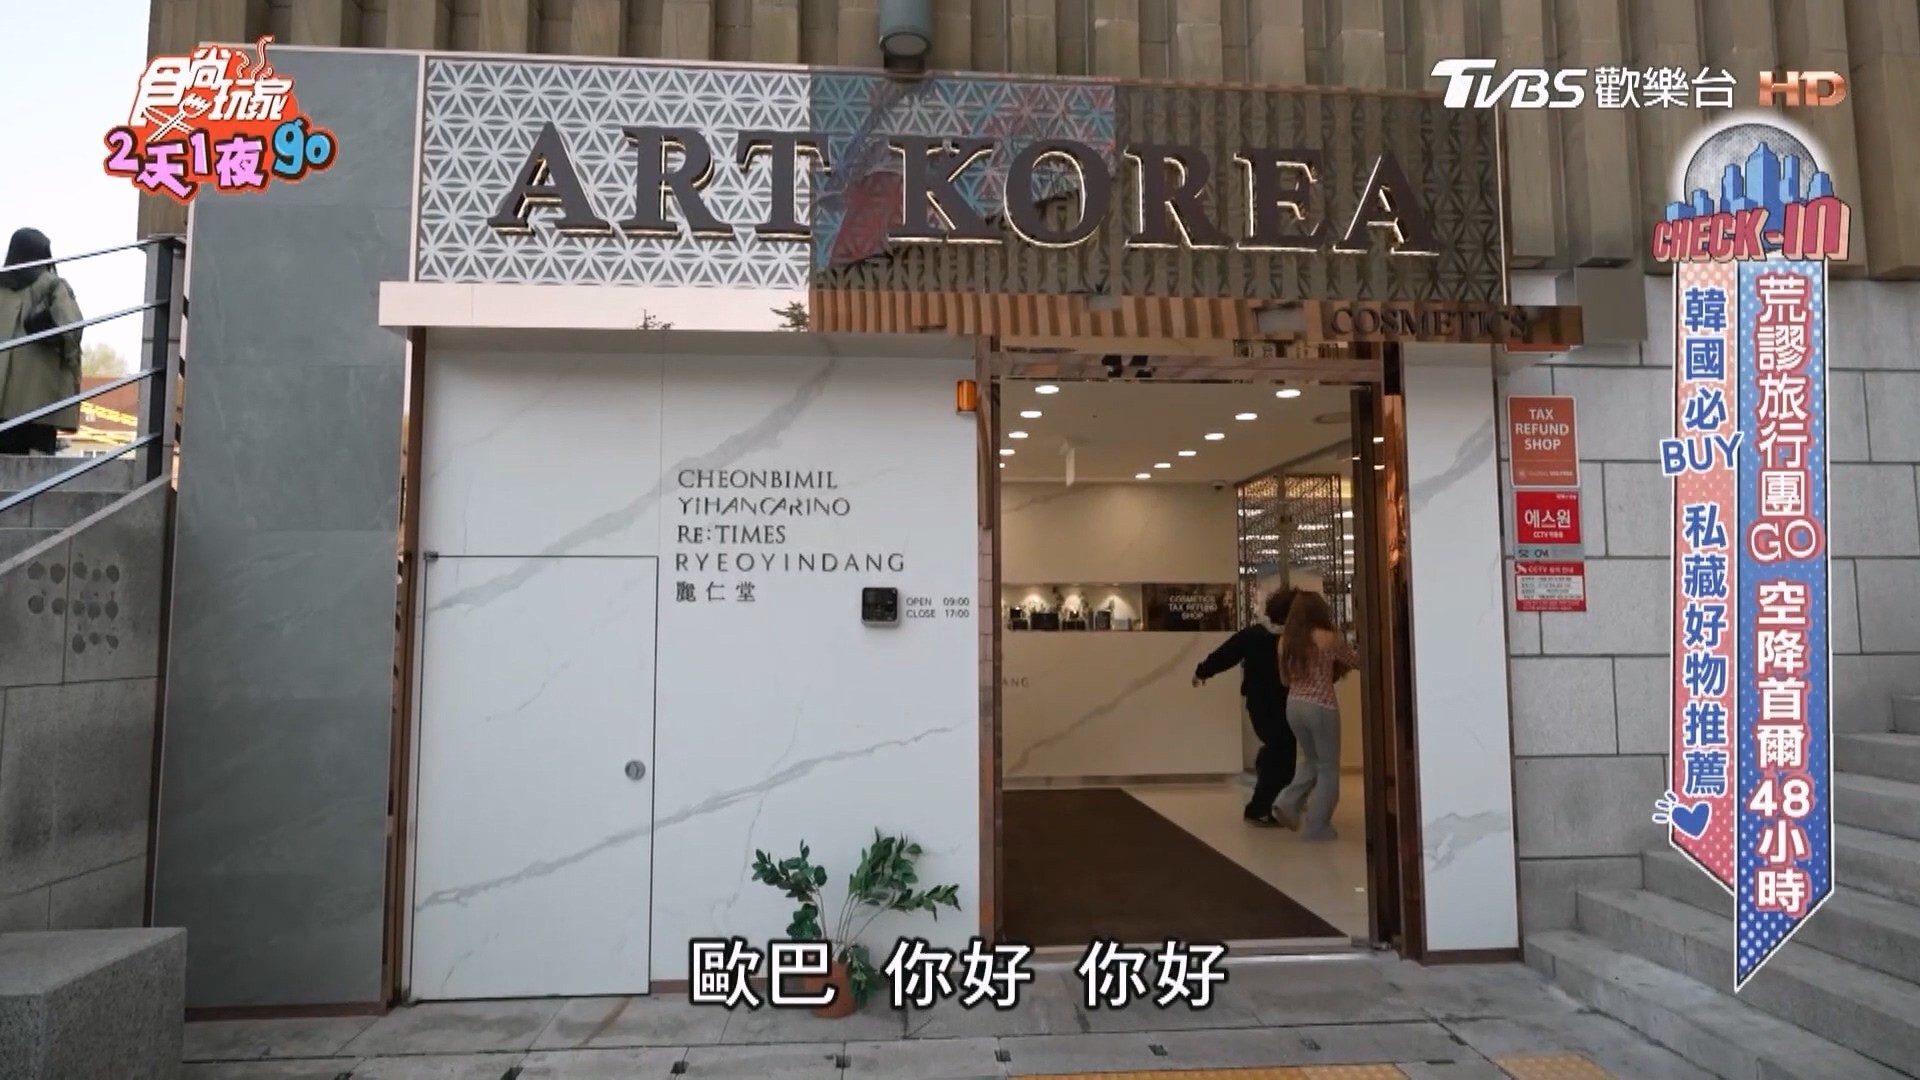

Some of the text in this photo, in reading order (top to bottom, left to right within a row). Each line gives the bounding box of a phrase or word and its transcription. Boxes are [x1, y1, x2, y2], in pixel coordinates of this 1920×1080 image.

[487, 120, 1441, 257] ART KOREA
[1330, 304, 1528, 338] COSMETICS
[1529, 408, 1554, 420] TAX
[1515, 423, 1569, 436] REFUND
[1524, 438, 1562, 451] SHOP
[677, 469, 839, 489] CHEONBIMIL
[677, 496, 851, 516] YIHANCARINO
[1524, 509, 1571, 528] 에스원
[675, 552, 905, 573] RYEOYINDANG
[675, 580, 757, 602] 麗仁堂
[905, 597, 970, 607] OPEN 09:00
[905, 609, 970, 619] CLOSE 17:00
